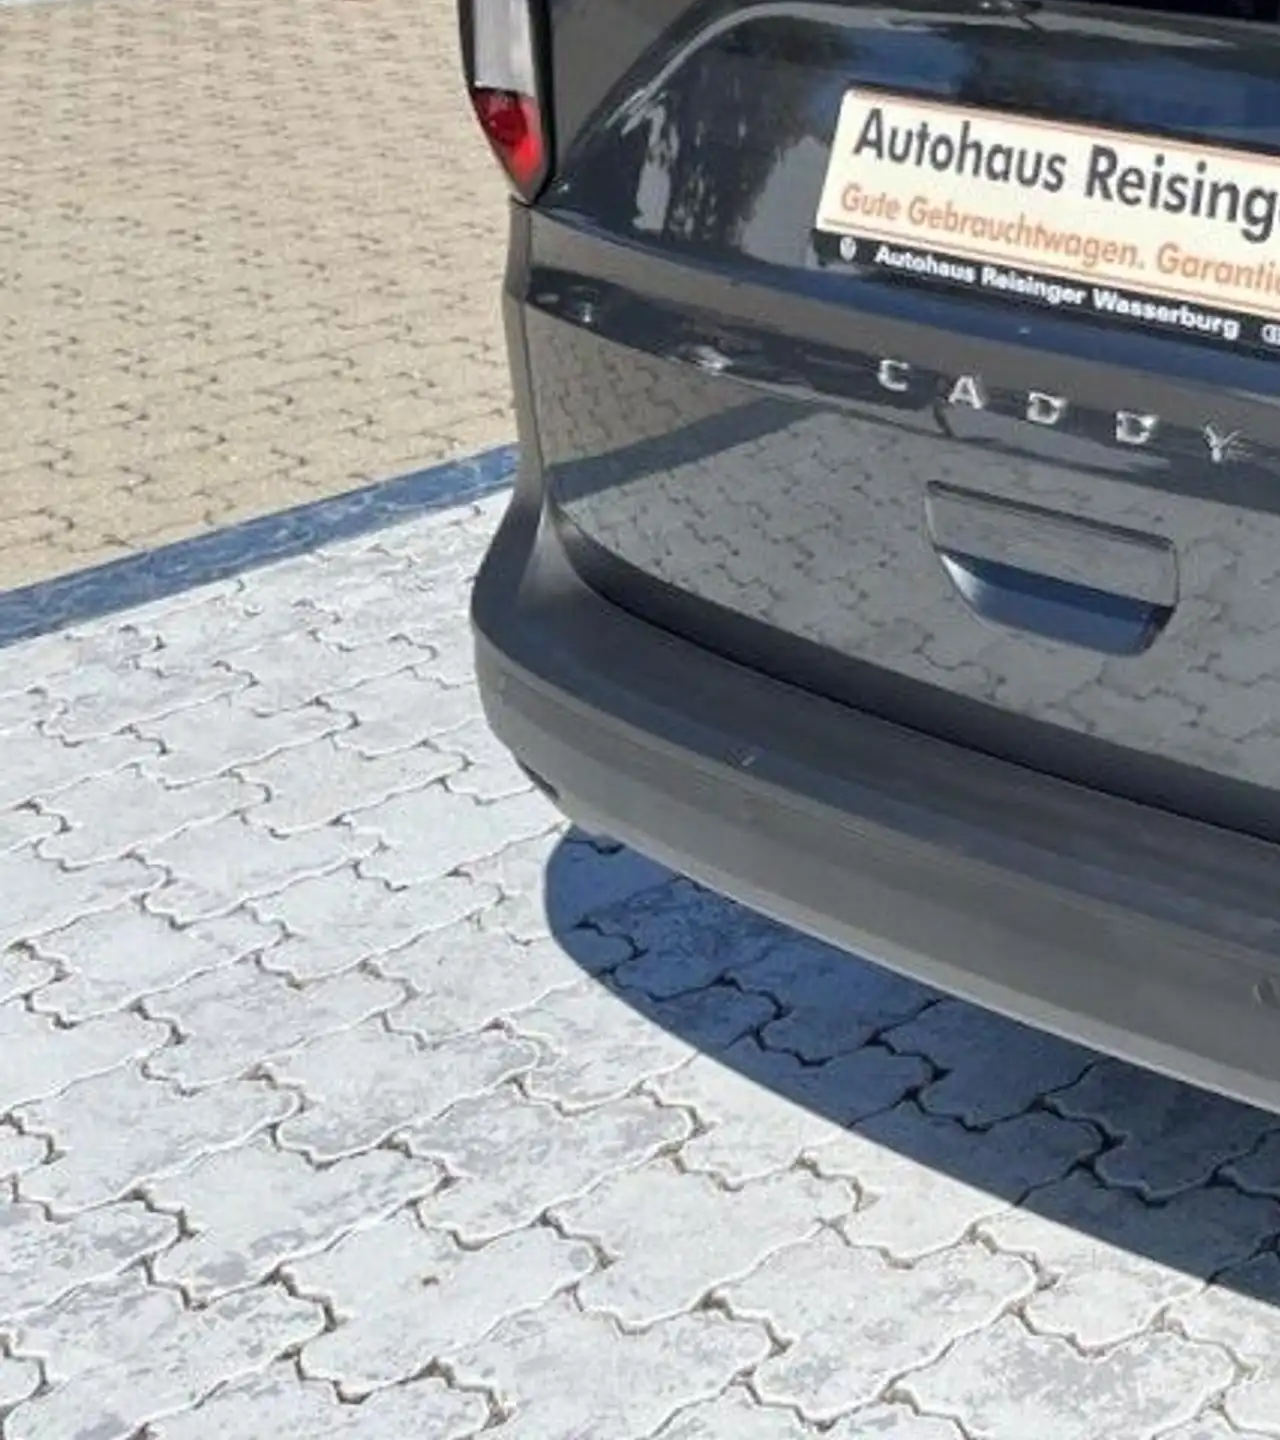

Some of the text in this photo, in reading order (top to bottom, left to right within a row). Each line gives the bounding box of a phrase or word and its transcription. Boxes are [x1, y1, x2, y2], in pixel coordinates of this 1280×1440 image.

[853, 108, 1068, 194] Autohaus
[840, 182, 901, 220] Gute
[908, 195, 1145, 270] Gebrauchtwagen.
[873, 245, 1241, 340] Autohaus Reisinger Wasserburg
[876, 359, 1243, 463] CADDY
